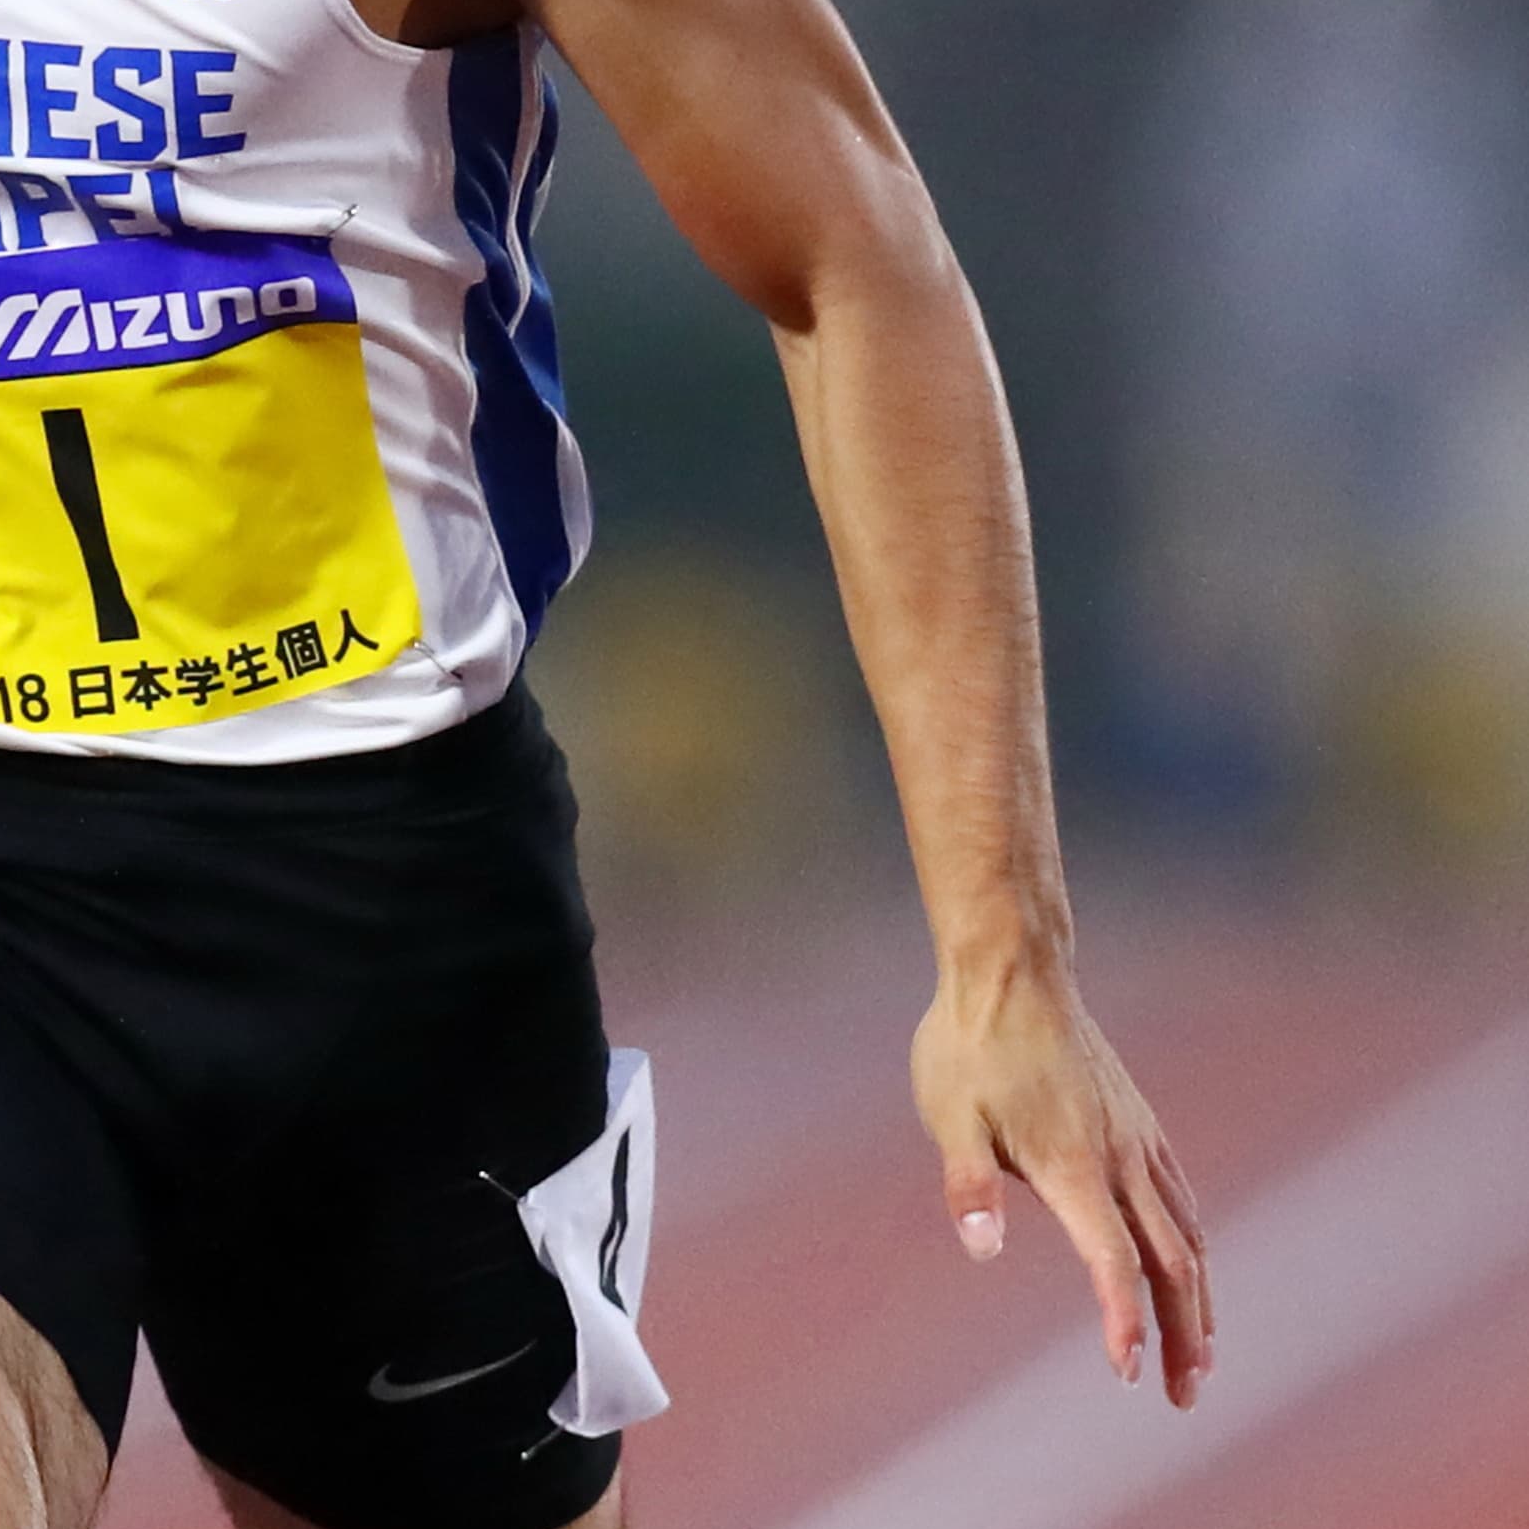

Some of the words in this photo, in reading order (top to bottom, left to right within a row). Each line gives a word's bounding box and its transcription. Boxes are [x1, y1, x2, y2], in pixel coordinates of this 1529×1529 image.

[42, 408, 139, 642] 1
[69, 608, 379, 718] 日本学生個人
